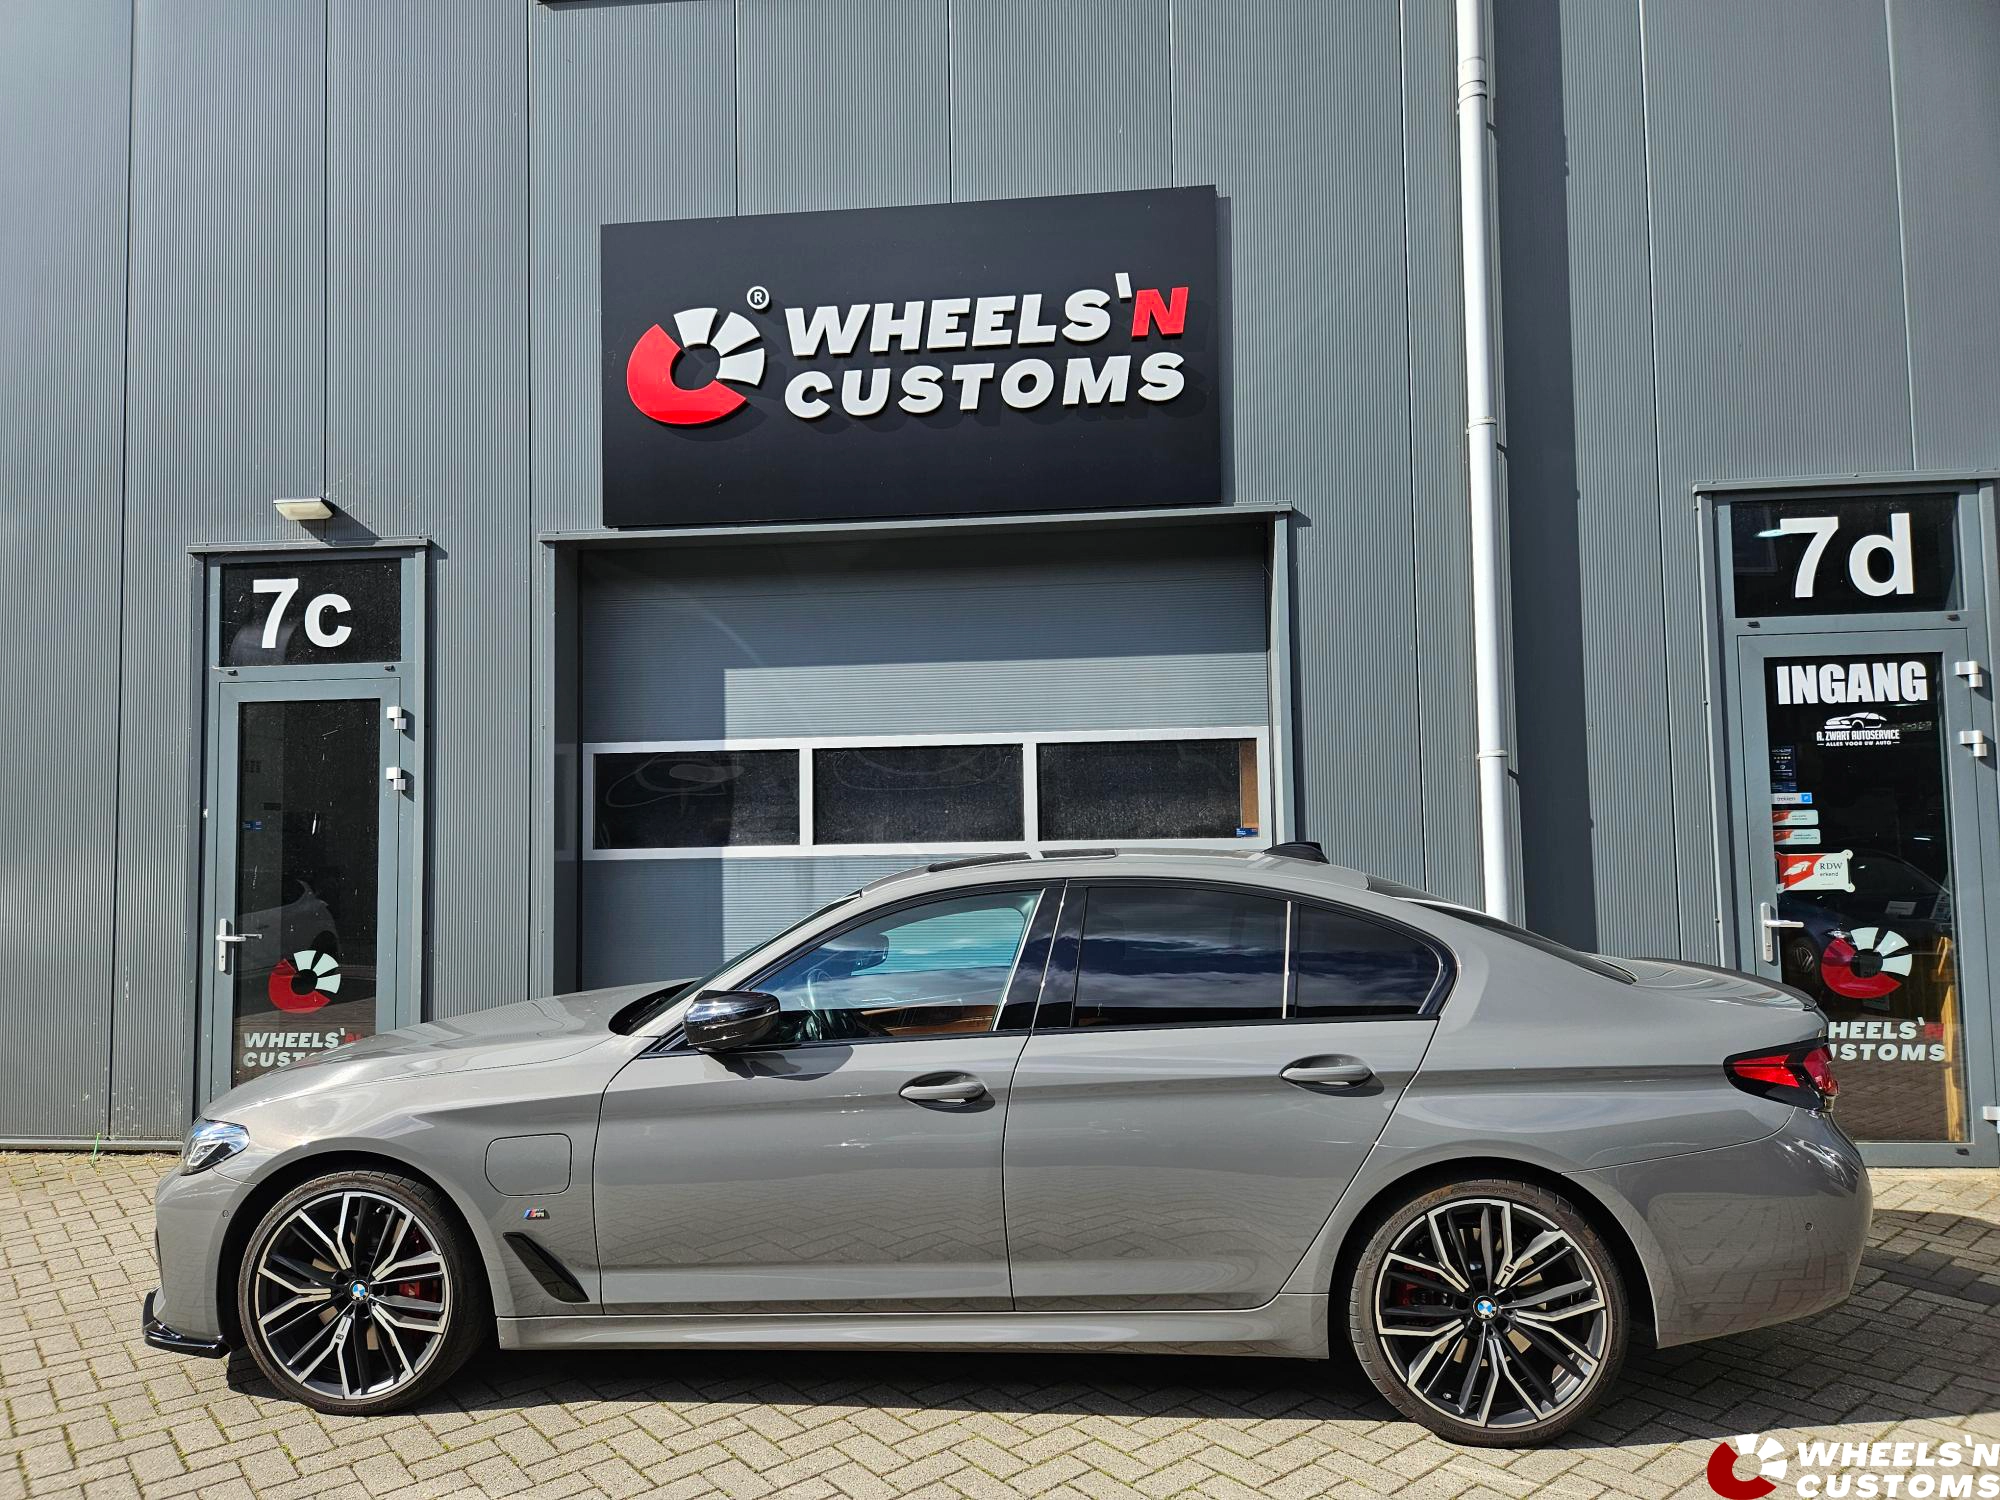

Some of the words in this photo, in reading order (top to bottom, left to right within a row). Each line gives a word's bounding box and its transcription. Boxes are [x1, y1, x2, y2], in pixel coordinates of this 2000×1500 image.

[784, 352, 1186, 418] CUSTOMS
[1780, 513, 1914, 598] 7d
[253, 578, 352, 648] 7c
[1777, 661, 1928, 704] INGANG
[1825, 731, 1850, 740] ZWART
[1851, 729, 1900, 740] AUTOSERVICE
[1820, 862, 1843, 870] RDW
[242, 1052, 318, 1067] CUST
[1829, 1043, 1945, 1061] STOMS
